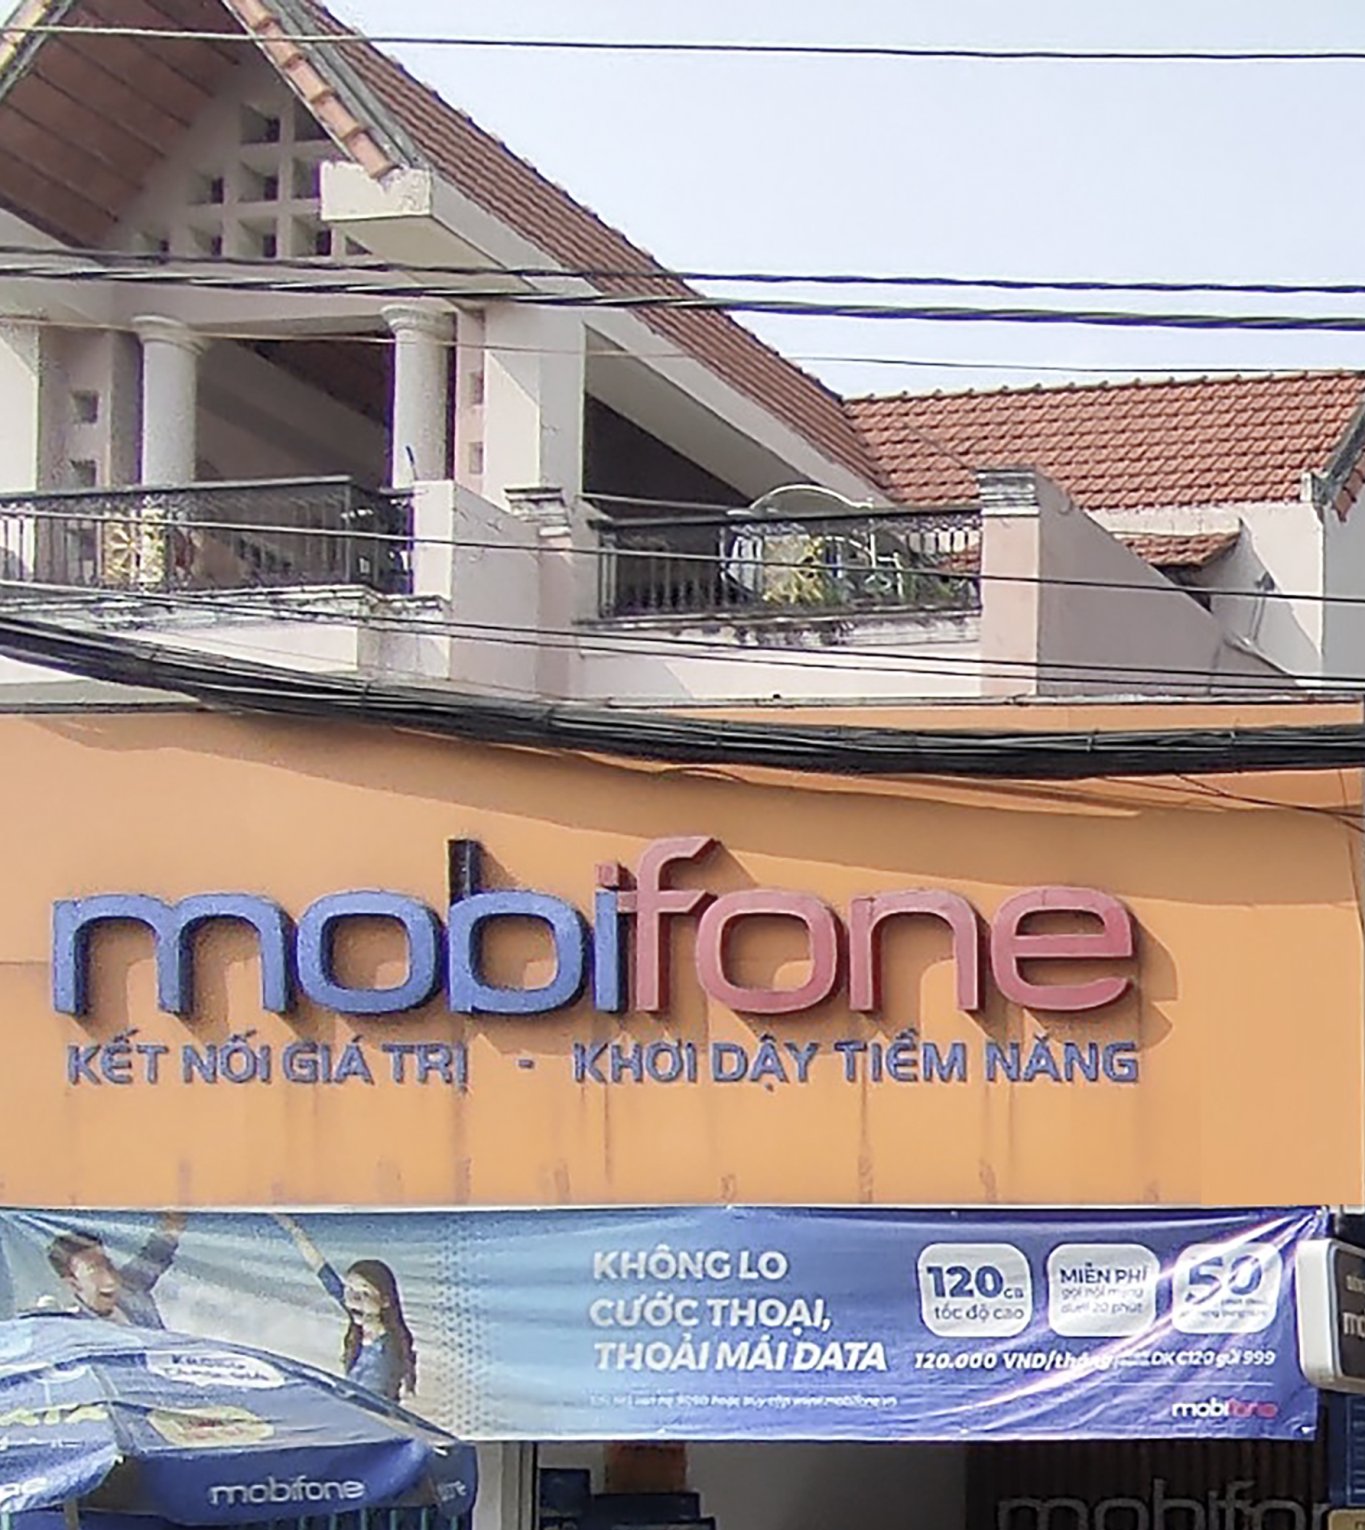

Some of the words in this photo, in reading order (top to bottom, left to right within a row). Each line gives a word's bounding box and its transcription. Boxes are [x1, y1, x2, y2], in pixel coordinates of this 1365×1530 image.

[51, 834, 1136, 1017] mobifone
[66, 1027, 169, 1086] KẾT
[181, 1028, 273, 1086] NỐI
[283, 1035, 376, 1086] GIÁ
[382, 1042, 471, 1097] TRỊ
[573, 1036, 698, 1084] KHƠI
[711, 1032, 820, 1093] DẬY
[834, 1027, 968, 1083] TIỀM
[984, 1027, 1140, 1084] NĂNG
[592, 1243, 731, 1281] KHÔNG
[738, 1250, 789, 1281] LO
[1059, 1261, 1111, 1284] MIỄN
[1114, 1264, 1148, 1284] PHÍ
[1186, 1254, 1263, 1305] 50
[925, 1264, 1004, 1299] 120
[589, 1289, 700, 1327] CƯỚC
[706, 1298, 833, 1336] THOẠI,
[934, 1304, 964, 1321] tốc
[966, 1302, 991, 1323] độ
[993, 1308, 1025, 1321] cao
[594, 1331, 709, 1372] THOẢI
[714, 1334, 788, 1372] MÁI
[792, 1341, 889, 1372] DATA
[914, 1351, 996, 1370] 120.000
[1241, 1350, 1277, 1367] 999
[1172, 1398, 1279, 1419] mobifone
[210, 1474, 366, 1505] mobifone
